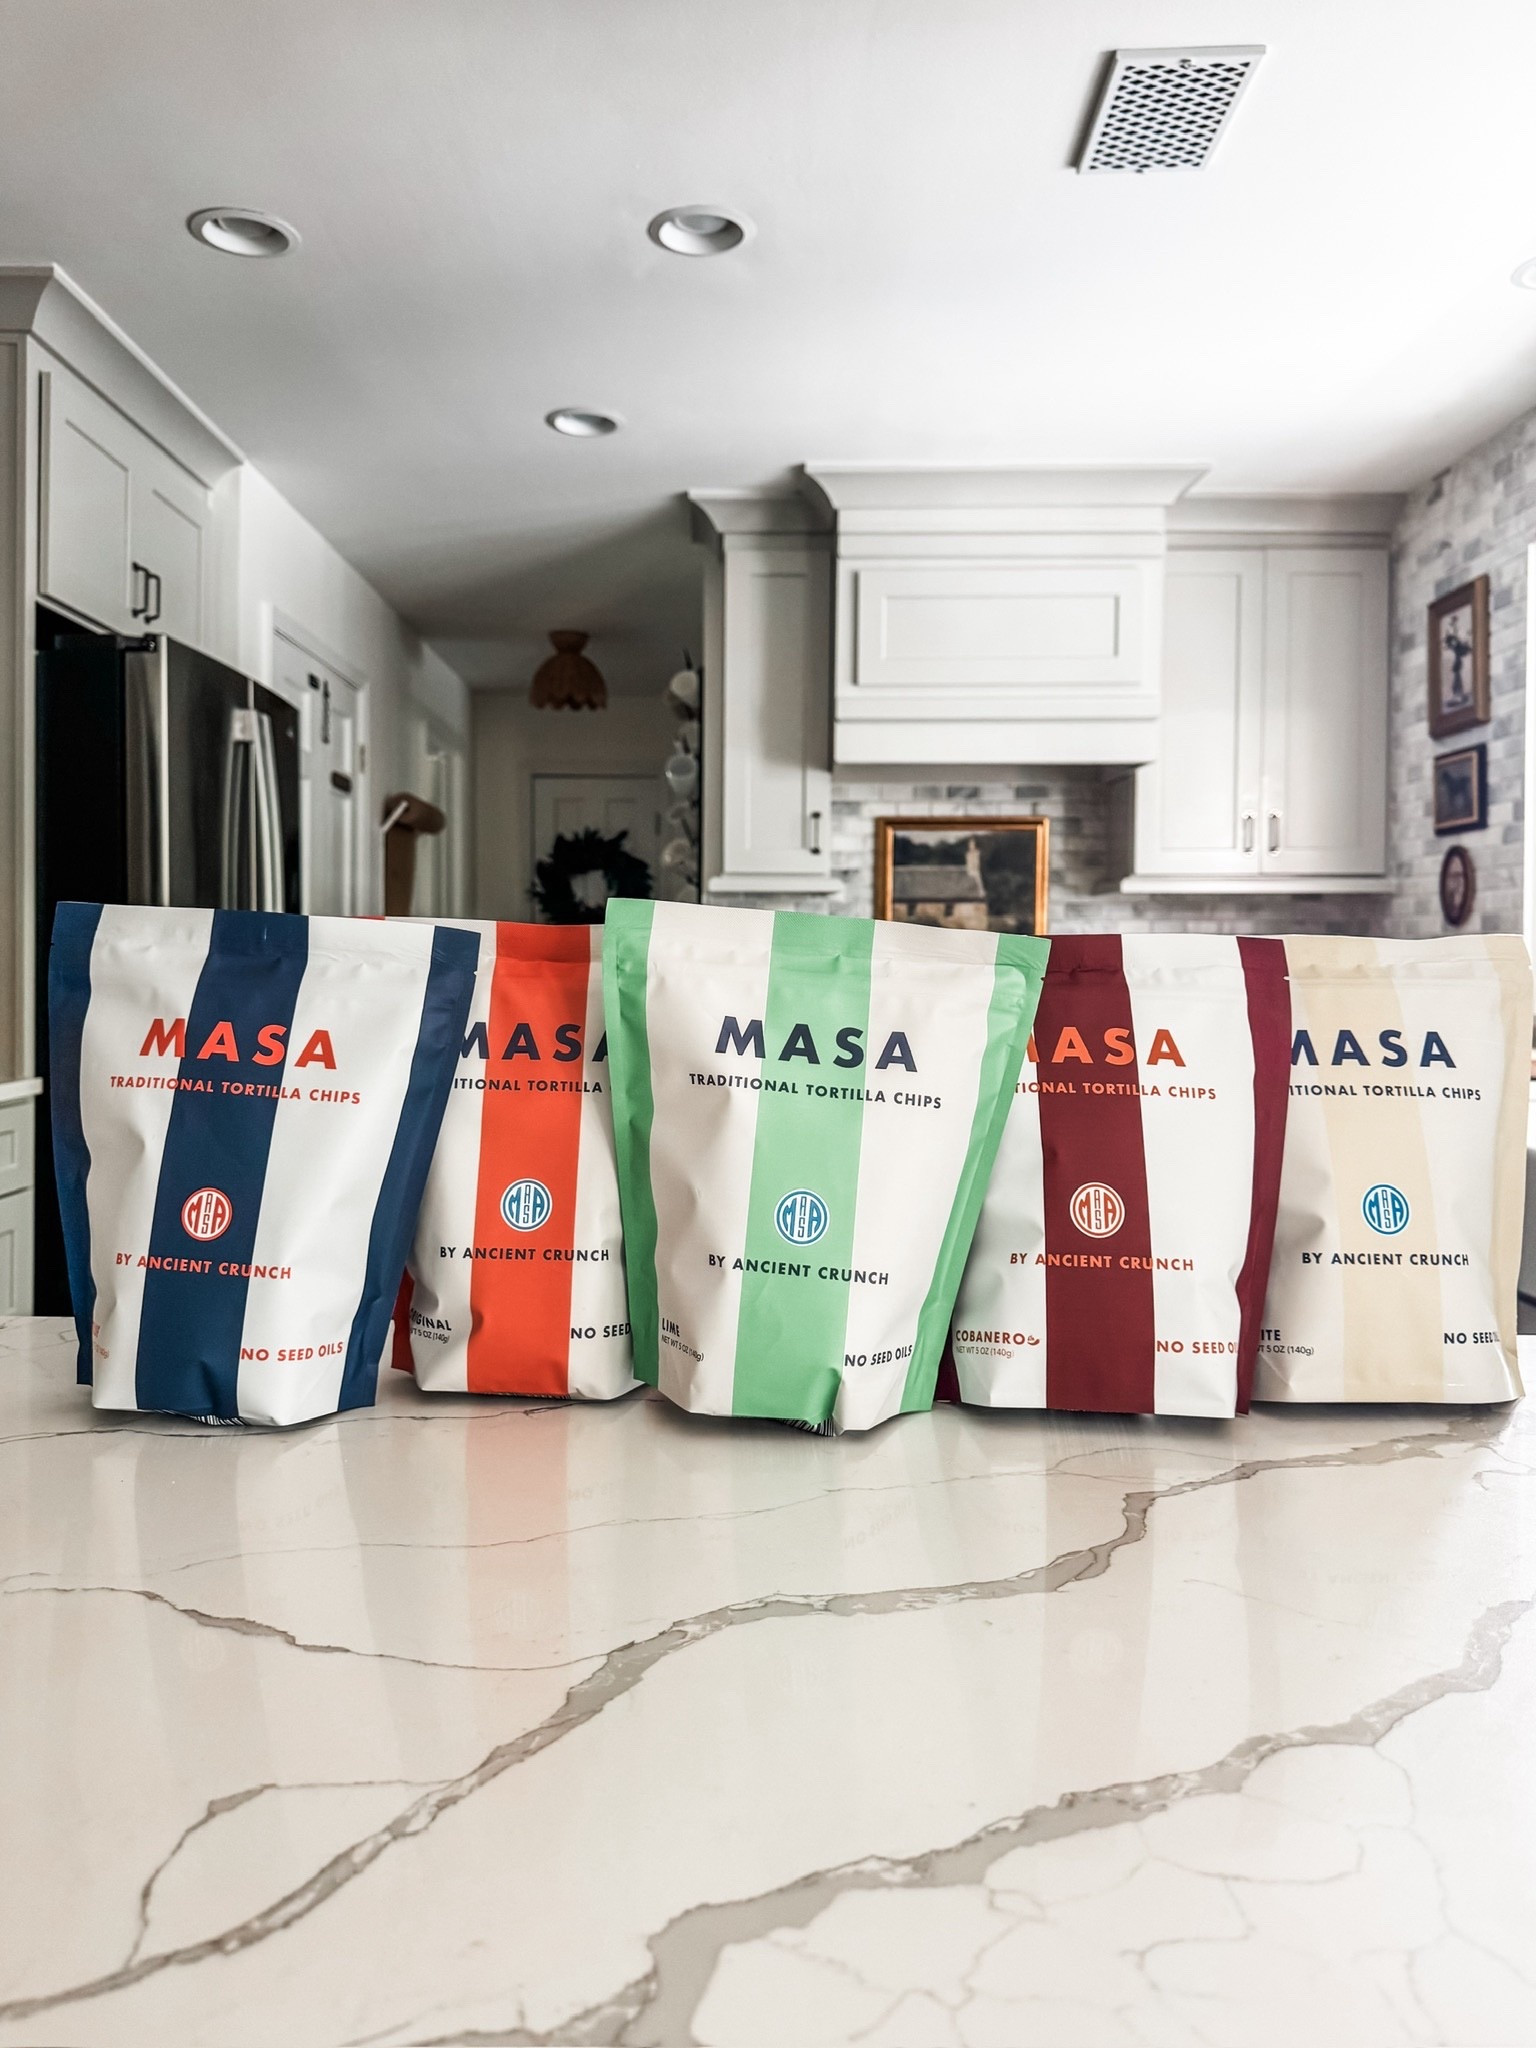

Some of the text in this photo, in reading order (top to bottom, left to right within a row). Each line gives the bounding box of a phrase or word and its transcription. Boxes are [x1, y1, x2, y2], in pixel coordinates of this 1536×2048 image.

[139, 1017, 338, 1070] MASA
[714, 1015, 918, 1073] MASA
[110, 1075, 361, 1105] TRADITIONAL TORTILLA CHIPS
[454, 1078, 521, 1092] ITIONAL
[527, 1080, 603, 1093] TORTILLA
[689, 1073, 942, 1110] TRADITIONAL TORTILLA CHIPS
[1014, 1082, 1217, 1100] TIONAL TORTILLA CHIPS
[1289, 1084, 1481, 1101] ITIONAL TORTILLA CHIPS
[440, 1246, 609, 1262] BY ANCIENT CRUNCH
[1010, 1253, 1194, 1271] BY ANCIENT CRUNCH
[1302, 1252, 1470, 1266] BY ANCIENT CRUNCH
[116, 1253, 292, 1280] BY ANCIENT CRUNCH
[708, 1253, 889, 1285] BY ANCIENT CRUNCH
[571, 1322, 631, 1340] NO SEED
[662, 1317, 680, 1337] LIME
[1261, 1329, 1281, 1341] ITE
[955, 1330, 1026, 1345] COBANERO
[1444, 1332, 1467, 1344] NO
[240, 1341, 344, 1362] NO SEED OILS
[844, 1344, 913, 1367] NO SEED OILS
[966, 1346, 974, 1354] WT
[975, 1346, 979, 1354] 5
[980, 1346, 989, 1355] OZ
[990, 1347, 1015, 1359] (140g)
[1157, 1340, 1184, 1353] NO
[1192, 1341, 1225, 1354] SEED
[1272, 1345, 1285, 1353] OZ
[1286, 1345, 1314, 1357] (140g)
